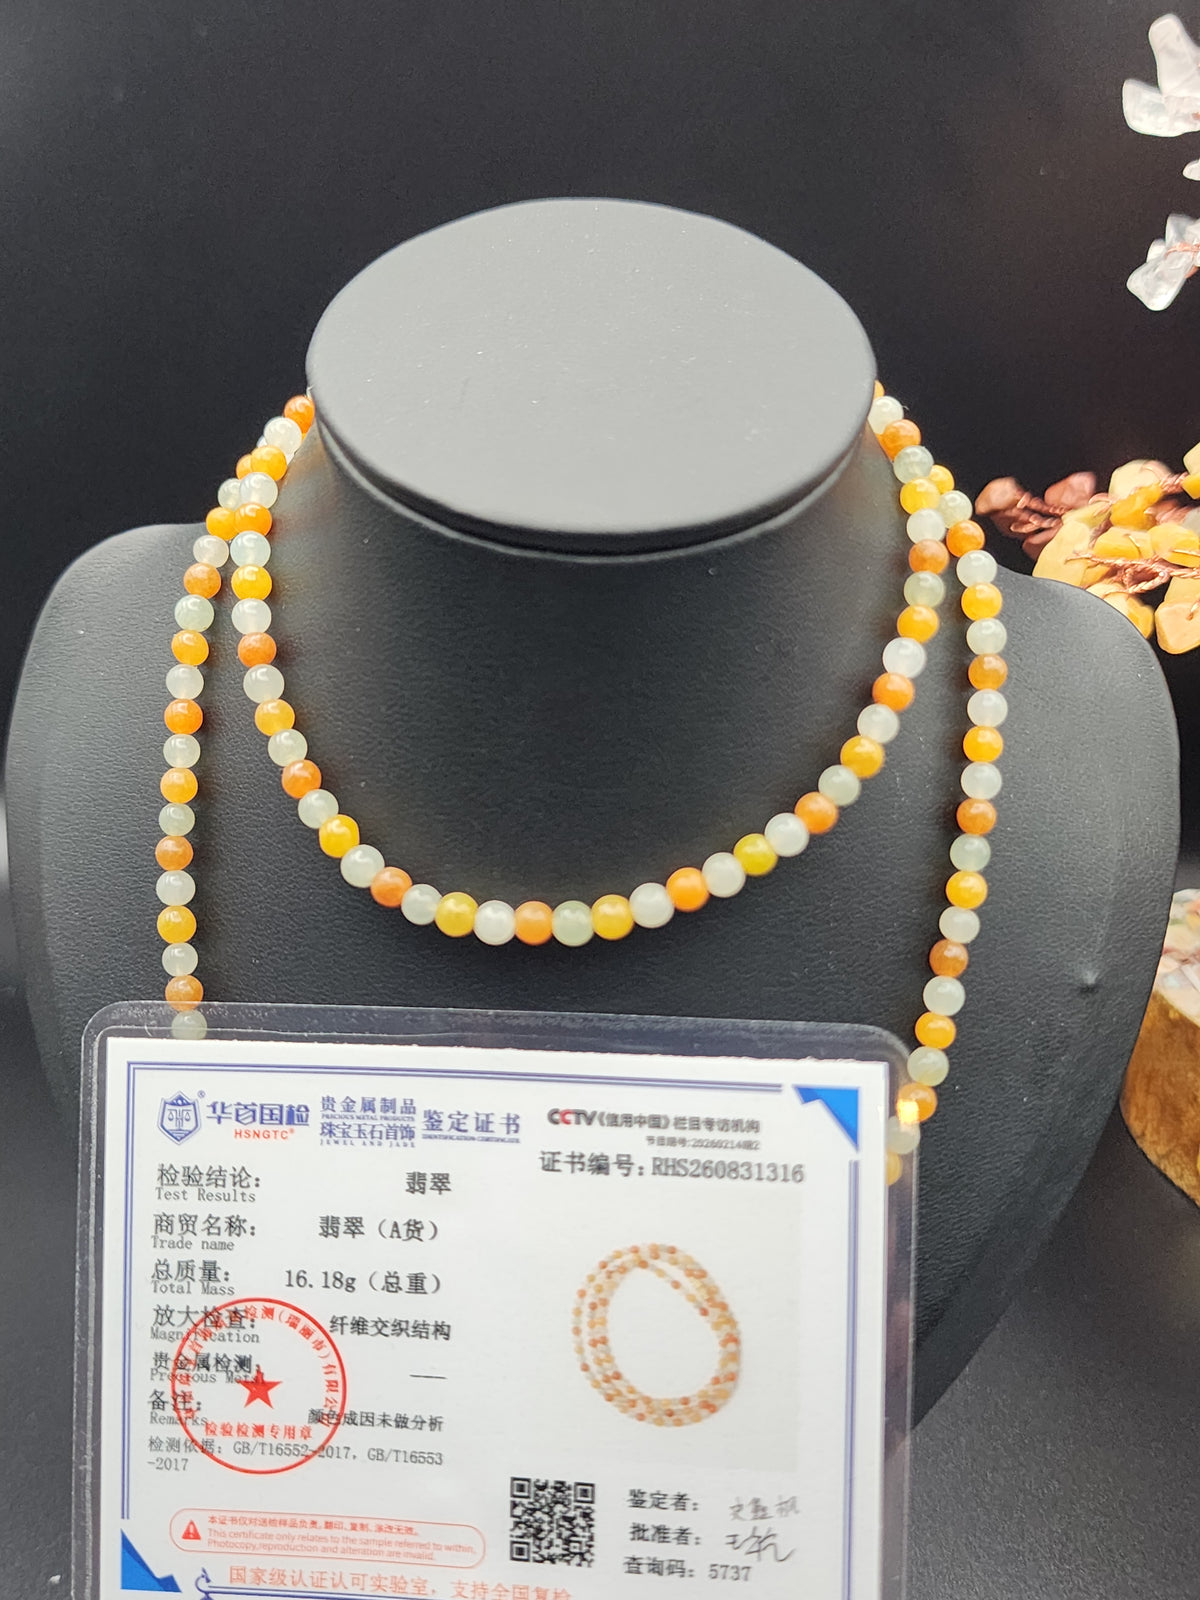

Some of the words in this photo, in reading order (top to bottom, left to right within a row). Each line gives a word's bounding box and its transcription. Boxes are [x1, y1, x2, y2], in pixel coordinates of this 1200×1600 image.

[320, 1095, 416, 1114] 贵金属制品
[320, 1122, 416, 1141] 珠宝玉石首饰
[422, 1109, 520, 1135] 鉴定证书
[652, 1156, 805, 1183] RHS260831316
[405, 1171, 451, 1195] 翡翠
[155, 1187, 188, 1200] Test
[197, 1187, 256, 1202] Results
[151, 1235, 193, 1250] Trade
[201, 1239, 235, 1251] name
[151, 1280, 192, 1296] Total
[201, 1281, 235, 1296] Mass
[150, 1326, 260, 1343] Magnfcation
[329, 1315, 451, 1340] 纤维交织结构
[307, 1407, 444, 1432] 颜色成因未做分析
[204, 1421, 313, 1441] 检验检测专用章
[147, 1457, 189, 1472] -2017
[367, 1447, 443, 1466] GB/T16553
[208, 1528, 227, 1538] This
[229, 1529, 273, 1540] certificate
[275, 1531, 295, 1542] only
[298, 1533, 328, 1543] relates
[330, 1535, 339, 1544] to
[342, 1535, 357, 1545] the
[359, 1536, 393, 1548] sample
[320, 1544, 339, 1553] and
[708, 1563, 753, 1581] 5737
